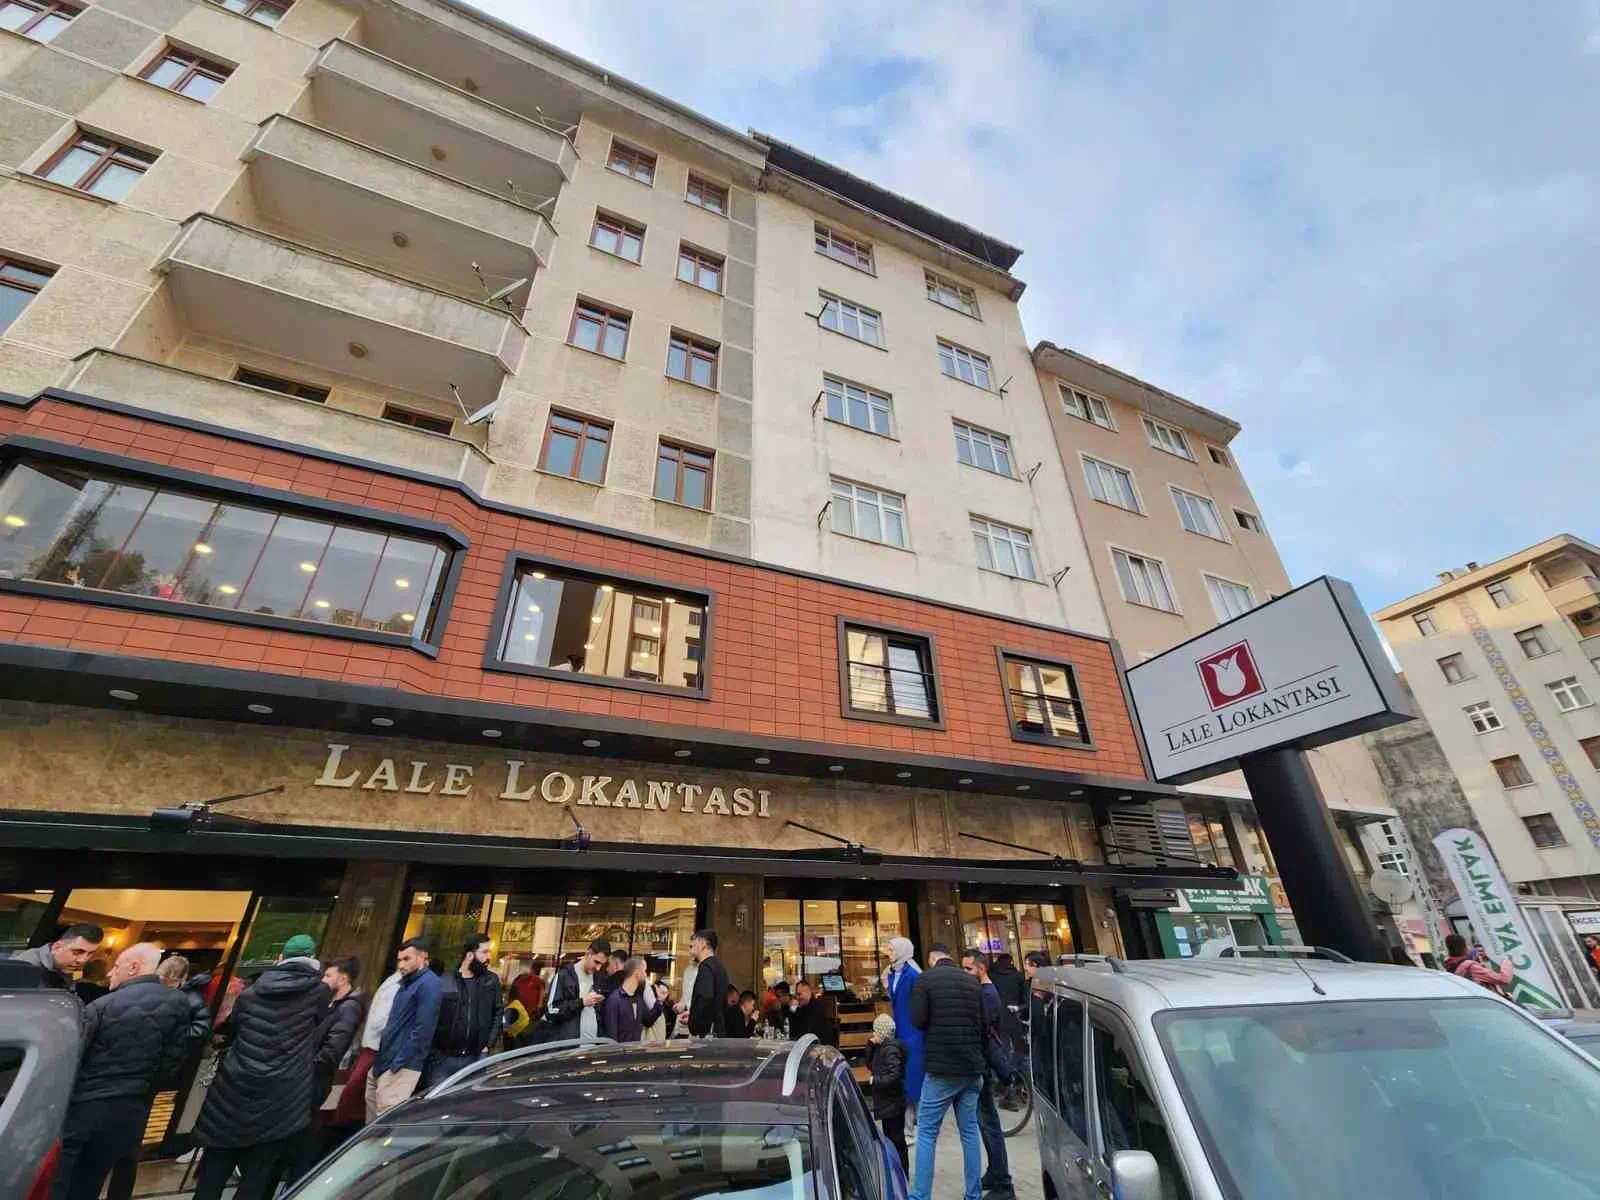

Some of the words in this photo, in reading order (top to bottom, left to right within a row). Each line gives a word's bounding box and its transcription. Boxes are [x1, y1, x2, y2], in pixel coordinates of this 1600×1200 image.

[1165, 724, 1213, 750] LALE
[1217, 677, 1341, 732] LOKANTASI
[314, 743, 473, 796] LALE
[500, 760, 771, 818] LOKANTASI
